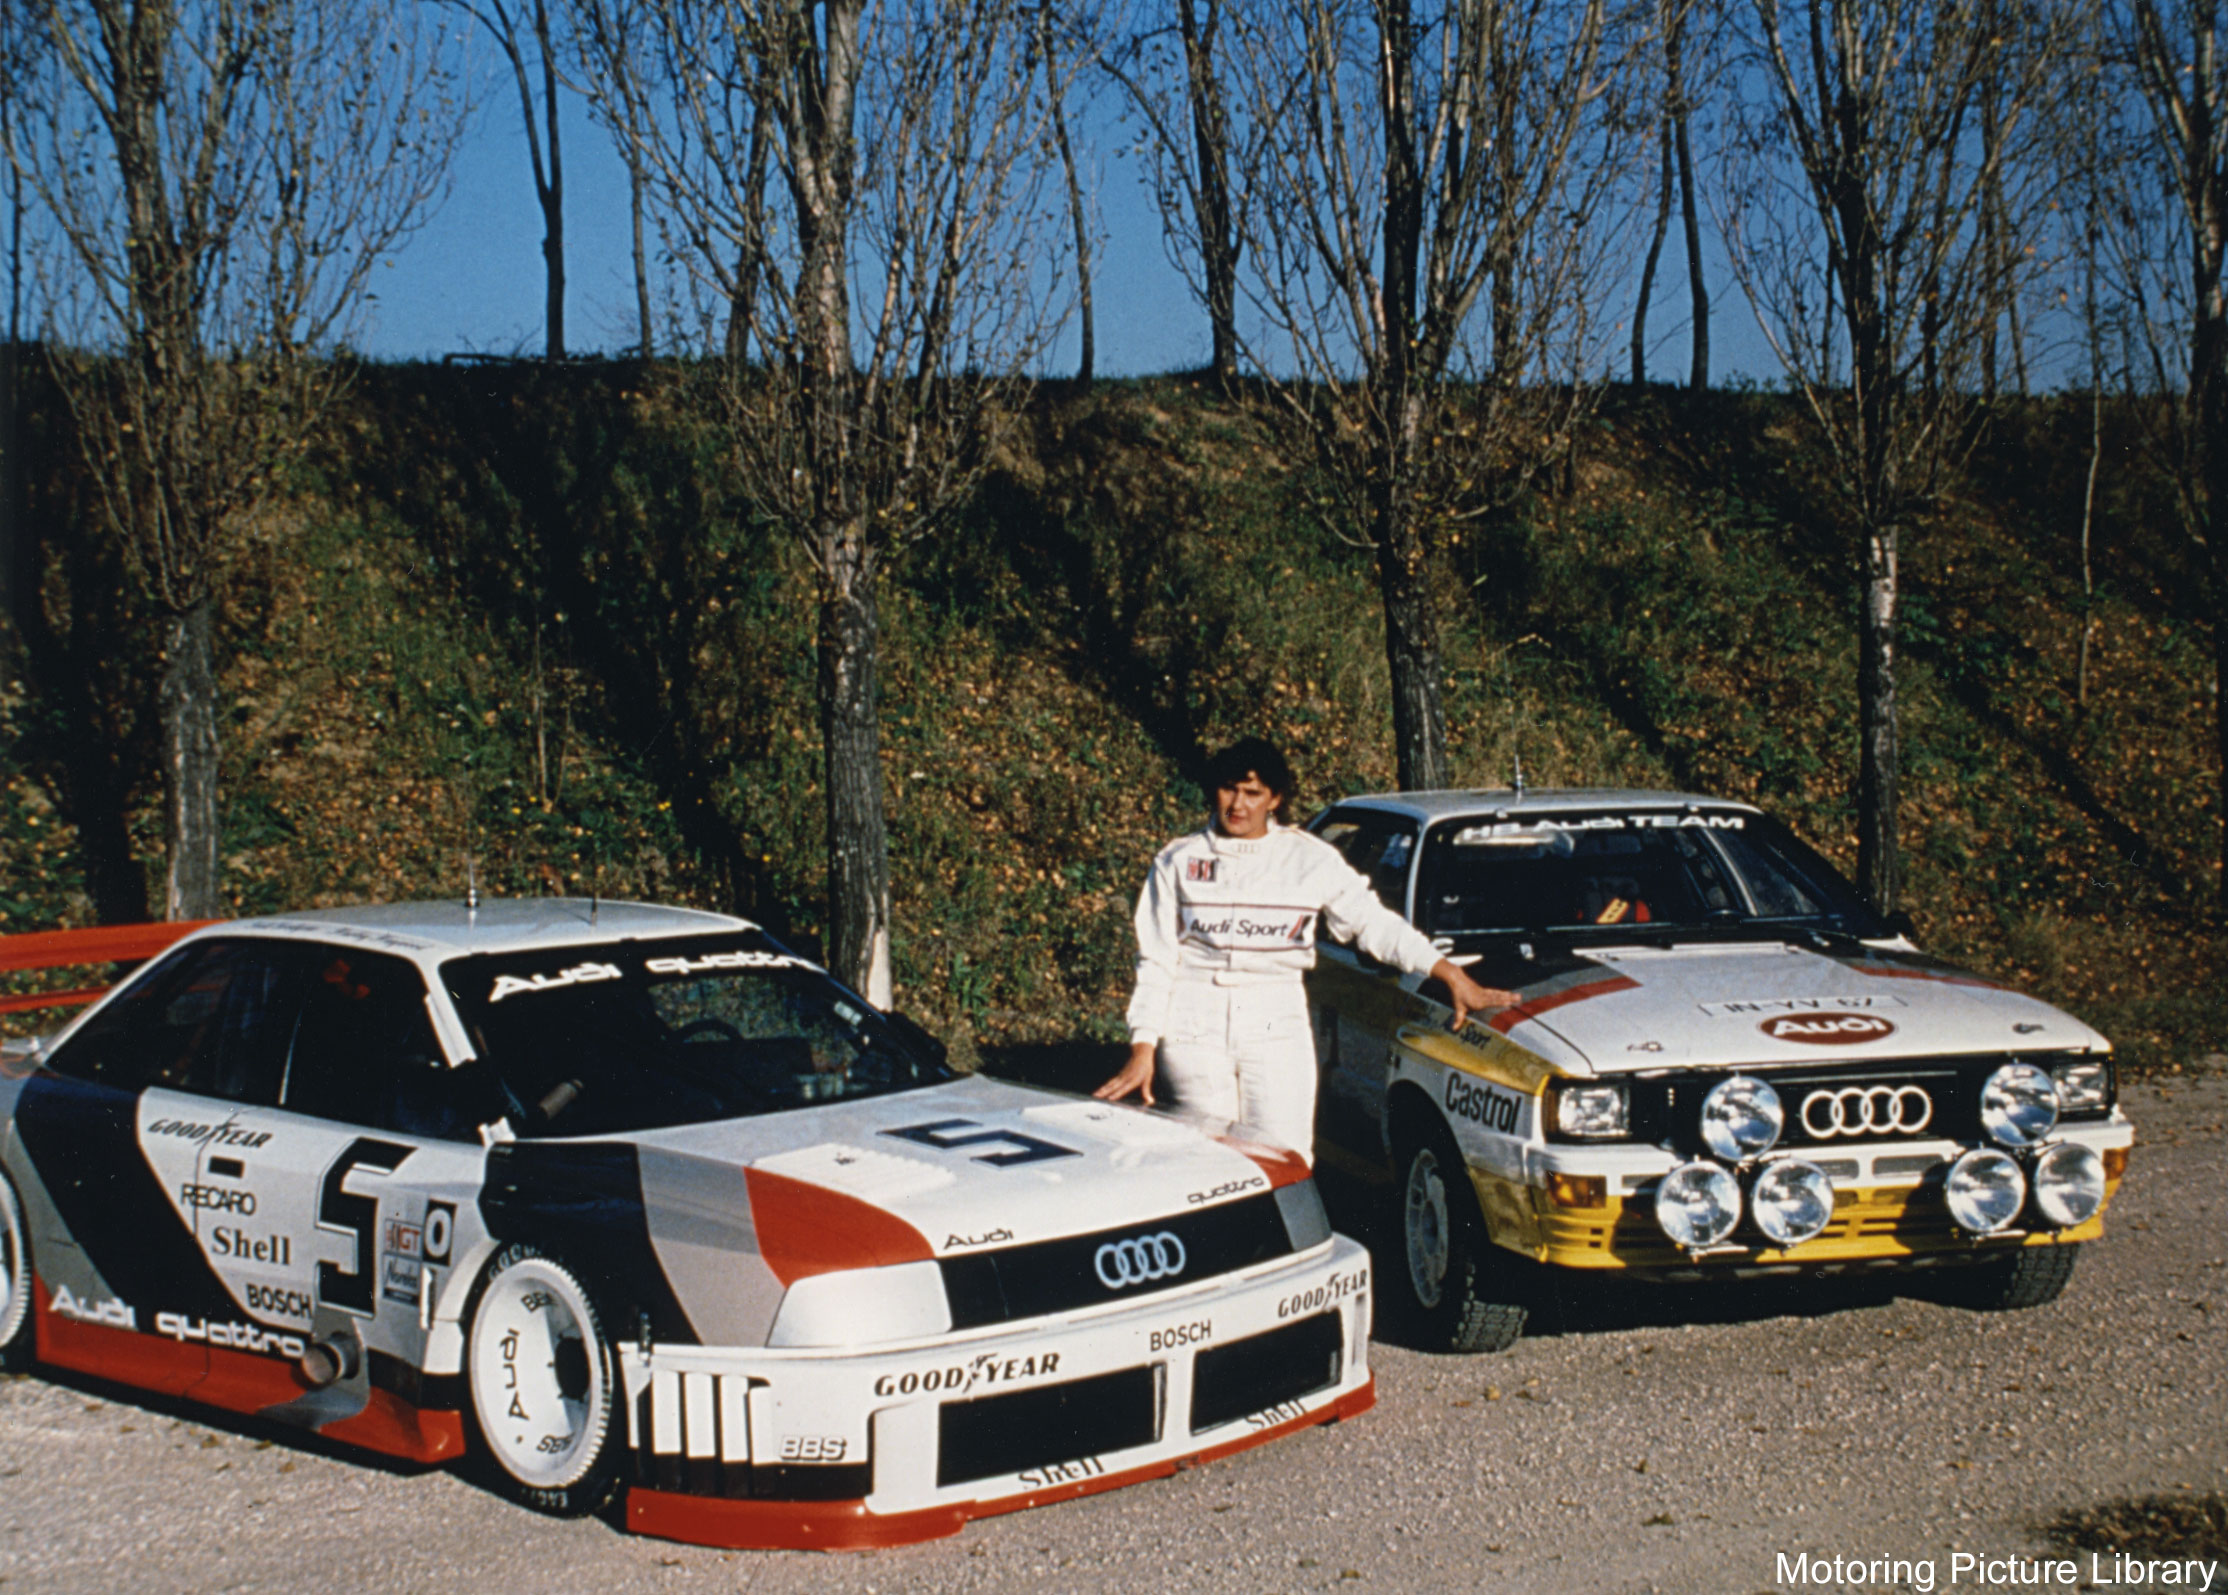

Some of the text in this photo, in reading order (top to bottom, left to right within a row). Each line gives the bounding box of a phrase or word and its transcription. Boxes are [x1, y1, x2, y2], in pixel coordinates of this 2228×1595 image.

[1463, 822, 1521, 840] HB
[1628, 815, 1745, 830] TEAM
[1190, 919, 1288, 938] Audi Sport
[489, 962, 622, 1002] Audi
[1772, 1017, 1888, 1037] Audi
[1445, 1071, 1523, 1136] Castrol
[876, 1118, 1084, 1168] 5
[180, 1182, 257, 1217] RECARO
[1187, 1176, 1265, 1205] quattro
[212, 1224, 291, 1266] Shell
[316, 1135, 420, 1321] 5
[943, 1227, 1014, 1251] Audi
[246, 1281, 313, 1319] BOSCH
[49, 1284, 305, 1359] Audi quattro
[1149, 1318, 1213, 1351] BOSCH
[499, 1327, 531, 1421] Audi
[779, 1435, 848, 1461] BBS
